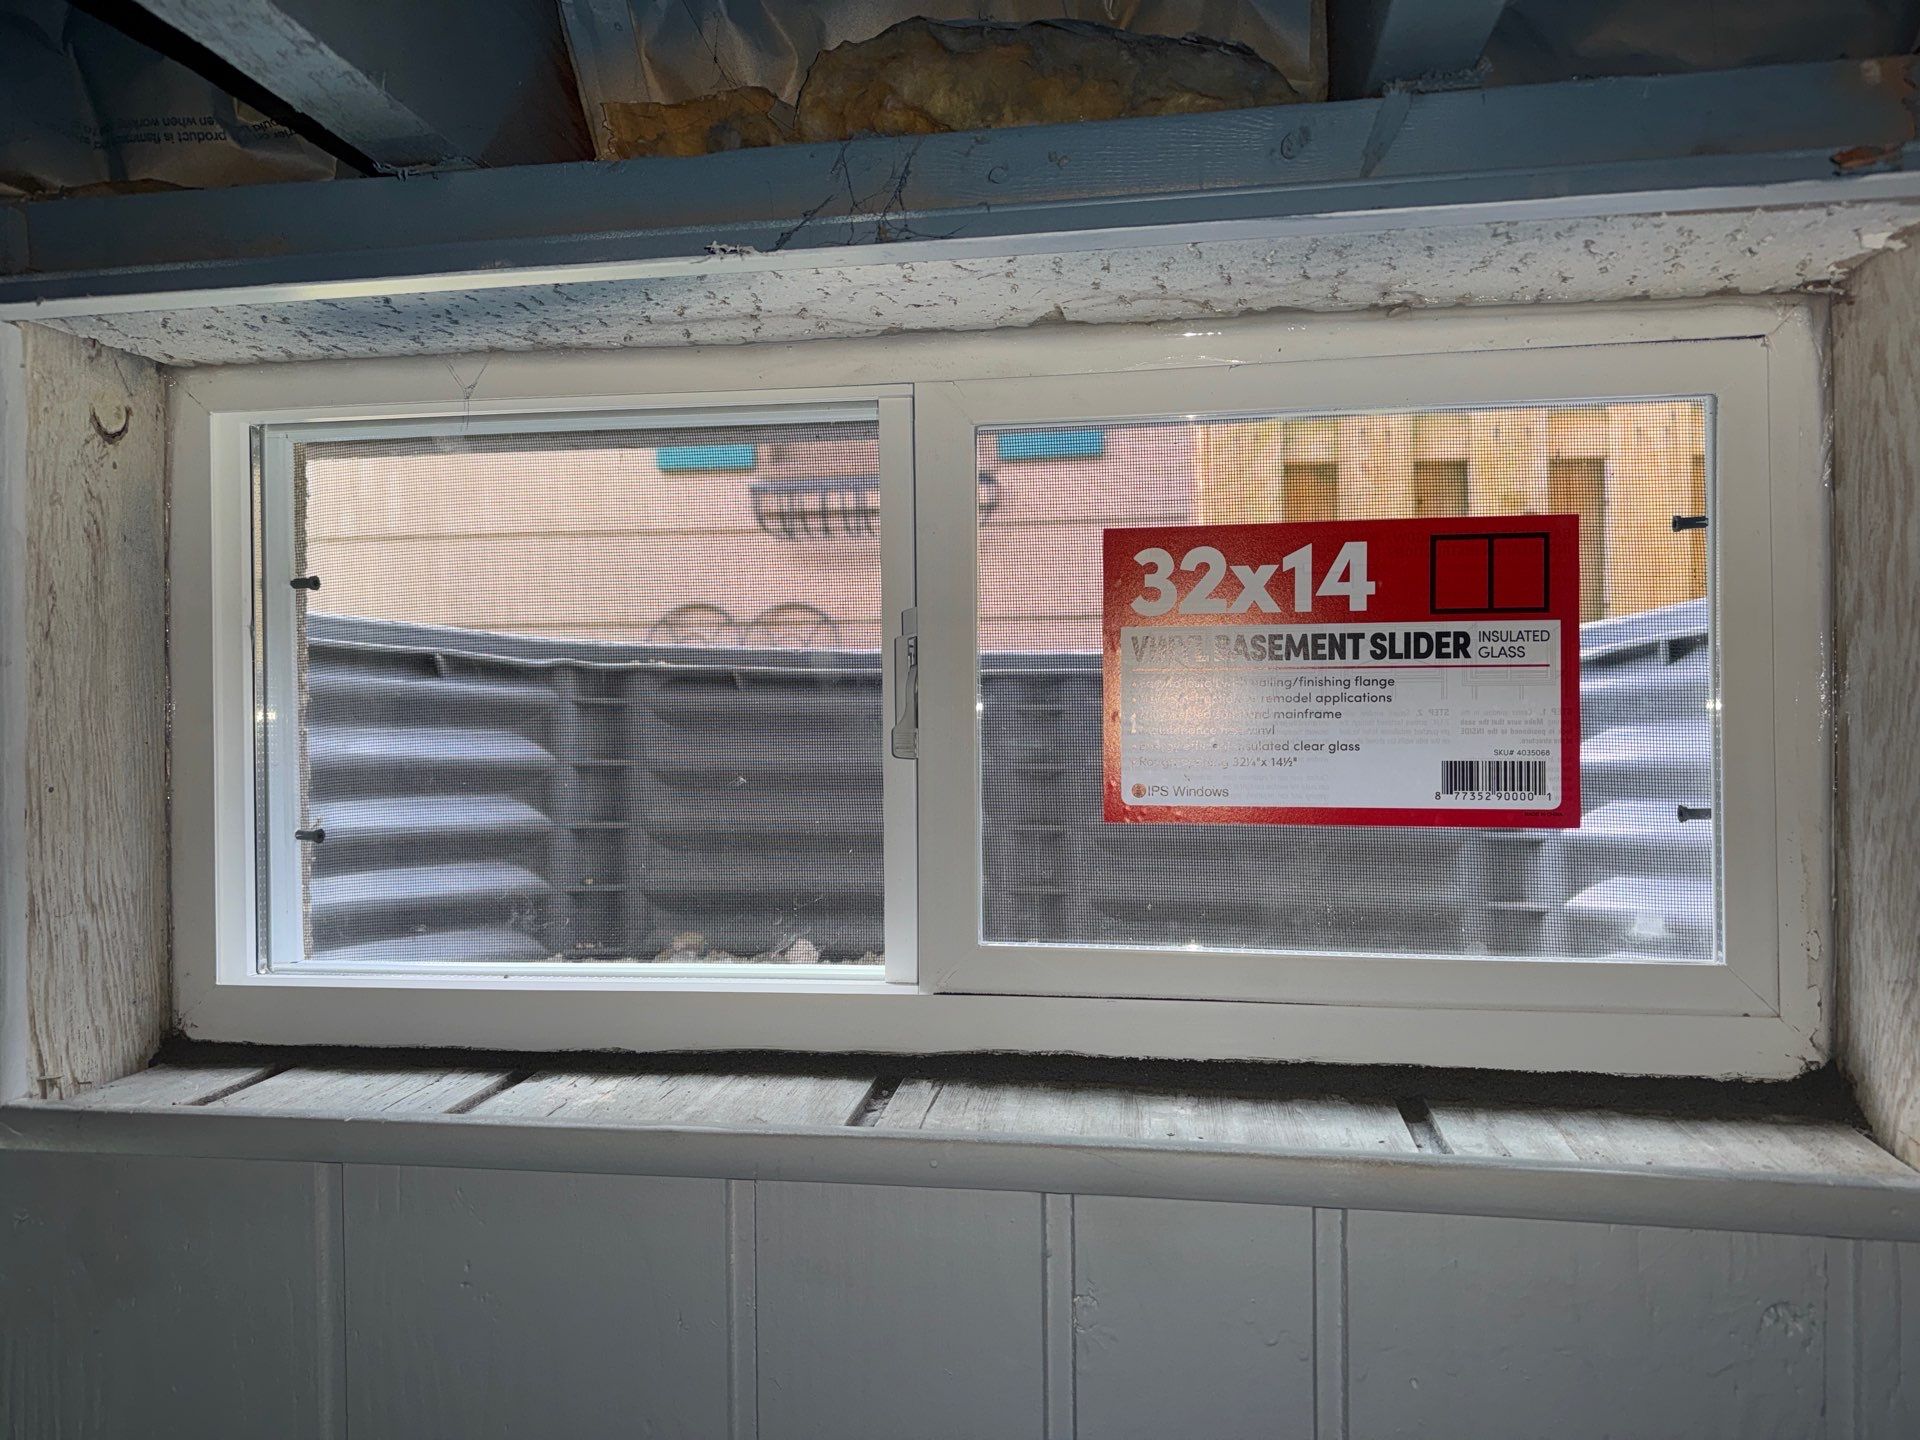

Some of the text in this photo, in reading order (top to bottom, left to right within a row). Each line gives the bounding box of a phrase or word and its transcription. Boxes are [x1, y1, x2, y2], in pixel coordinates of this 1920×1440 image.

[162, 116, 196, 128] when
[164, 132, 175, 144] is
[177, 130, 227, 144] product
[1132, 541, 1376, 617] 32x14
[1478, 629, 1550, 644] INSULATED
[1213, 632, 1365, 662] BASEMENT
[1369, 630, 1471, 660] SLIDER
[1478, 645, 1526, 659] GLASS
[1354, 675, 1395, 690] flange
[1261, 692, 1312, 703] remodel
[1315, 692, 1393, 706] applications
[1273, 708, 1342, 719] mainframe
[1293, 740, 1325, 751] clear
[1328, 740, 1361, 754] glass
[1493, 749, 1551, 757] SKU# 4035068
[1147, 785, 1169, 797] IPS
[1172, 785, 1230, 798] Windows
[1434, 791, 1442, 801] 8
[1547, 792, 1552, 801] 1
